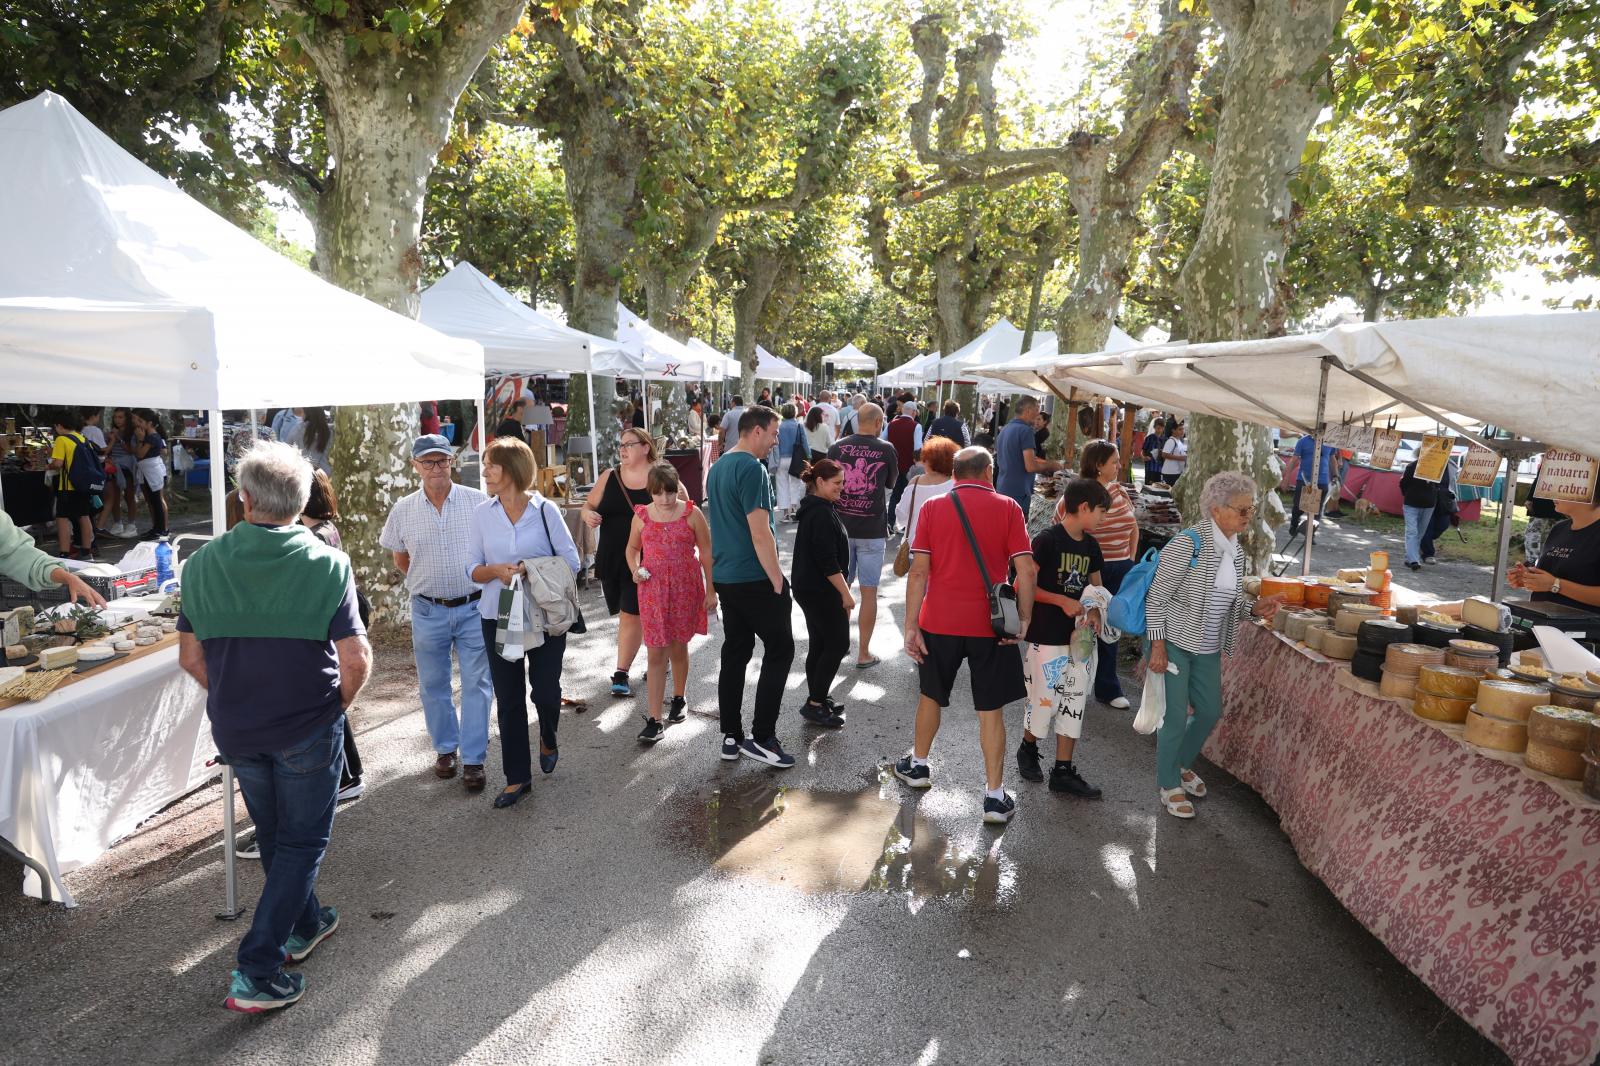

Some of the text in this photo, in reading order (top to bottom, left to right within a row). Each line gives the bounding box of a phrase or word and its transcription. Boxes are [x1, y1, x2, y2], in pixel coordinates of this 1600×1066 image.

[1546, 448, 1581, 462] Queso
[1541, 481, 1588, 496] de cabra
[1057, 552, 1090, 576] JUDO
